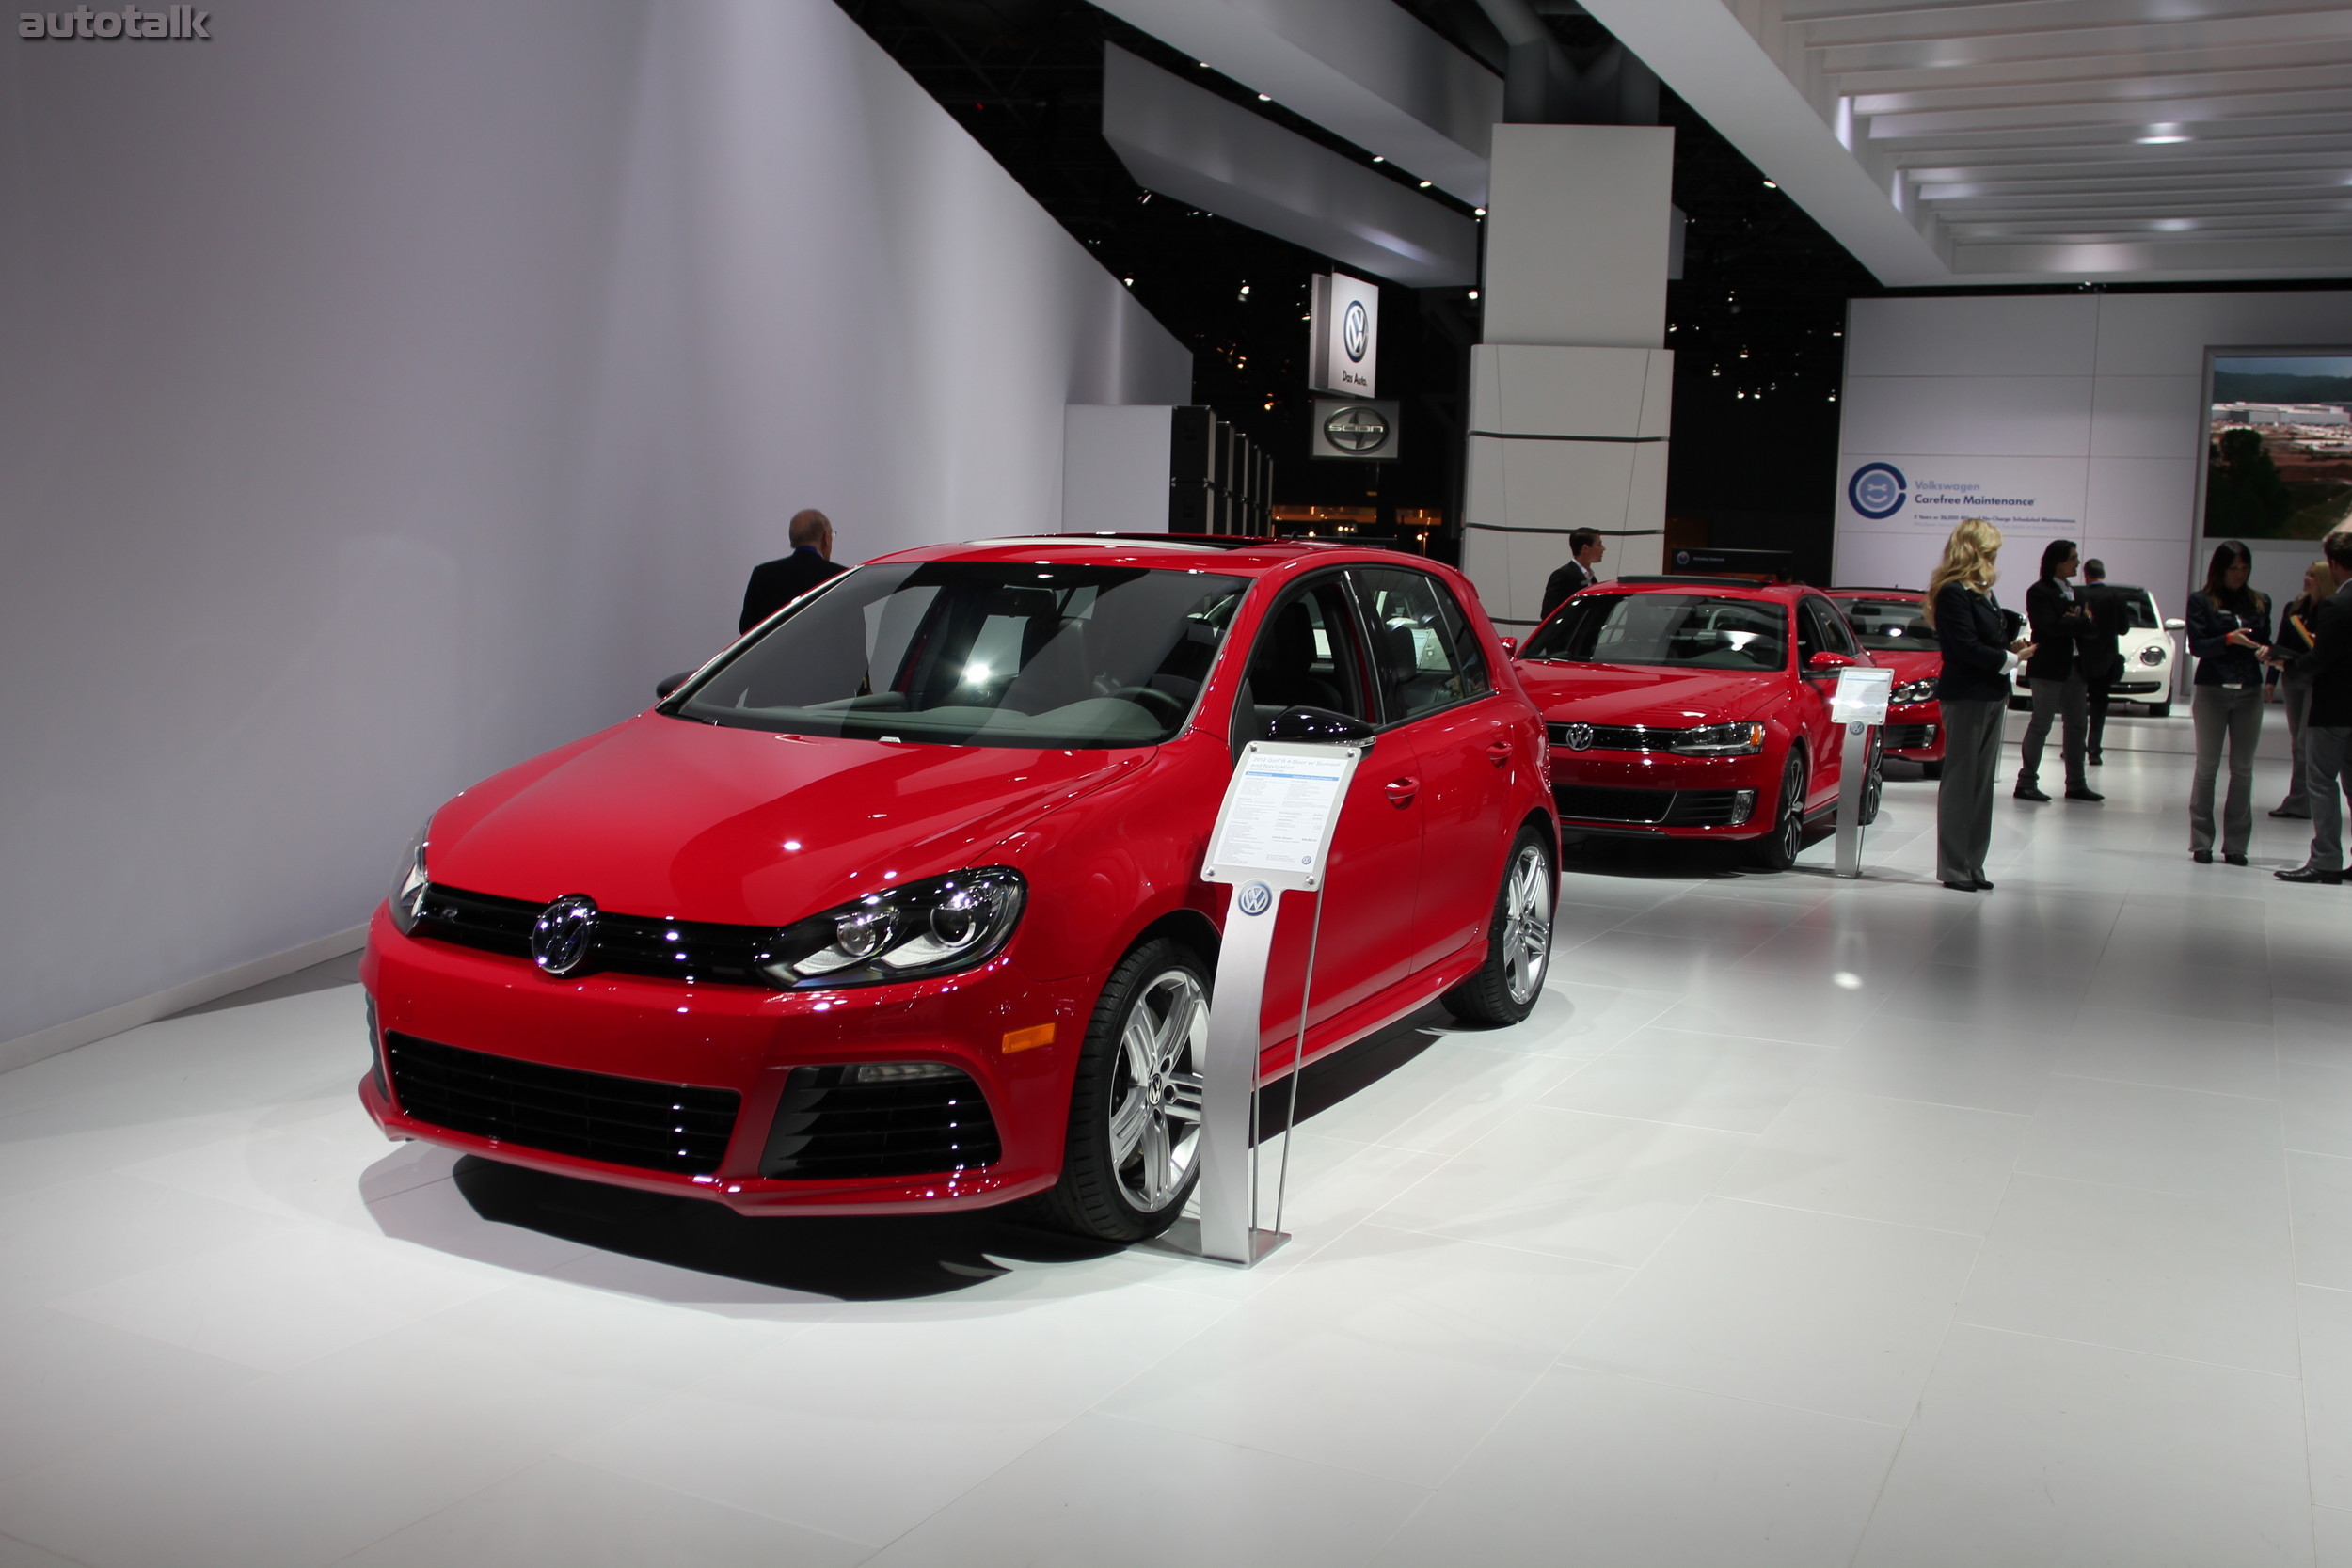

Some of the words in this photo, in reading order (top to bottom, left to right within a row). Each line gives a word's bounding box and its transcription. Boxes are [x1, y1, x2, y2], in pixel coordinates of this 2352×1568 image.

[1343, 370, 1353, 383] Das
[1354, 372, 1368, 387] Auto.
[1915, 480, 1980, 493] Volkswagen
[1915, 494, 1961, 505] Carefree
